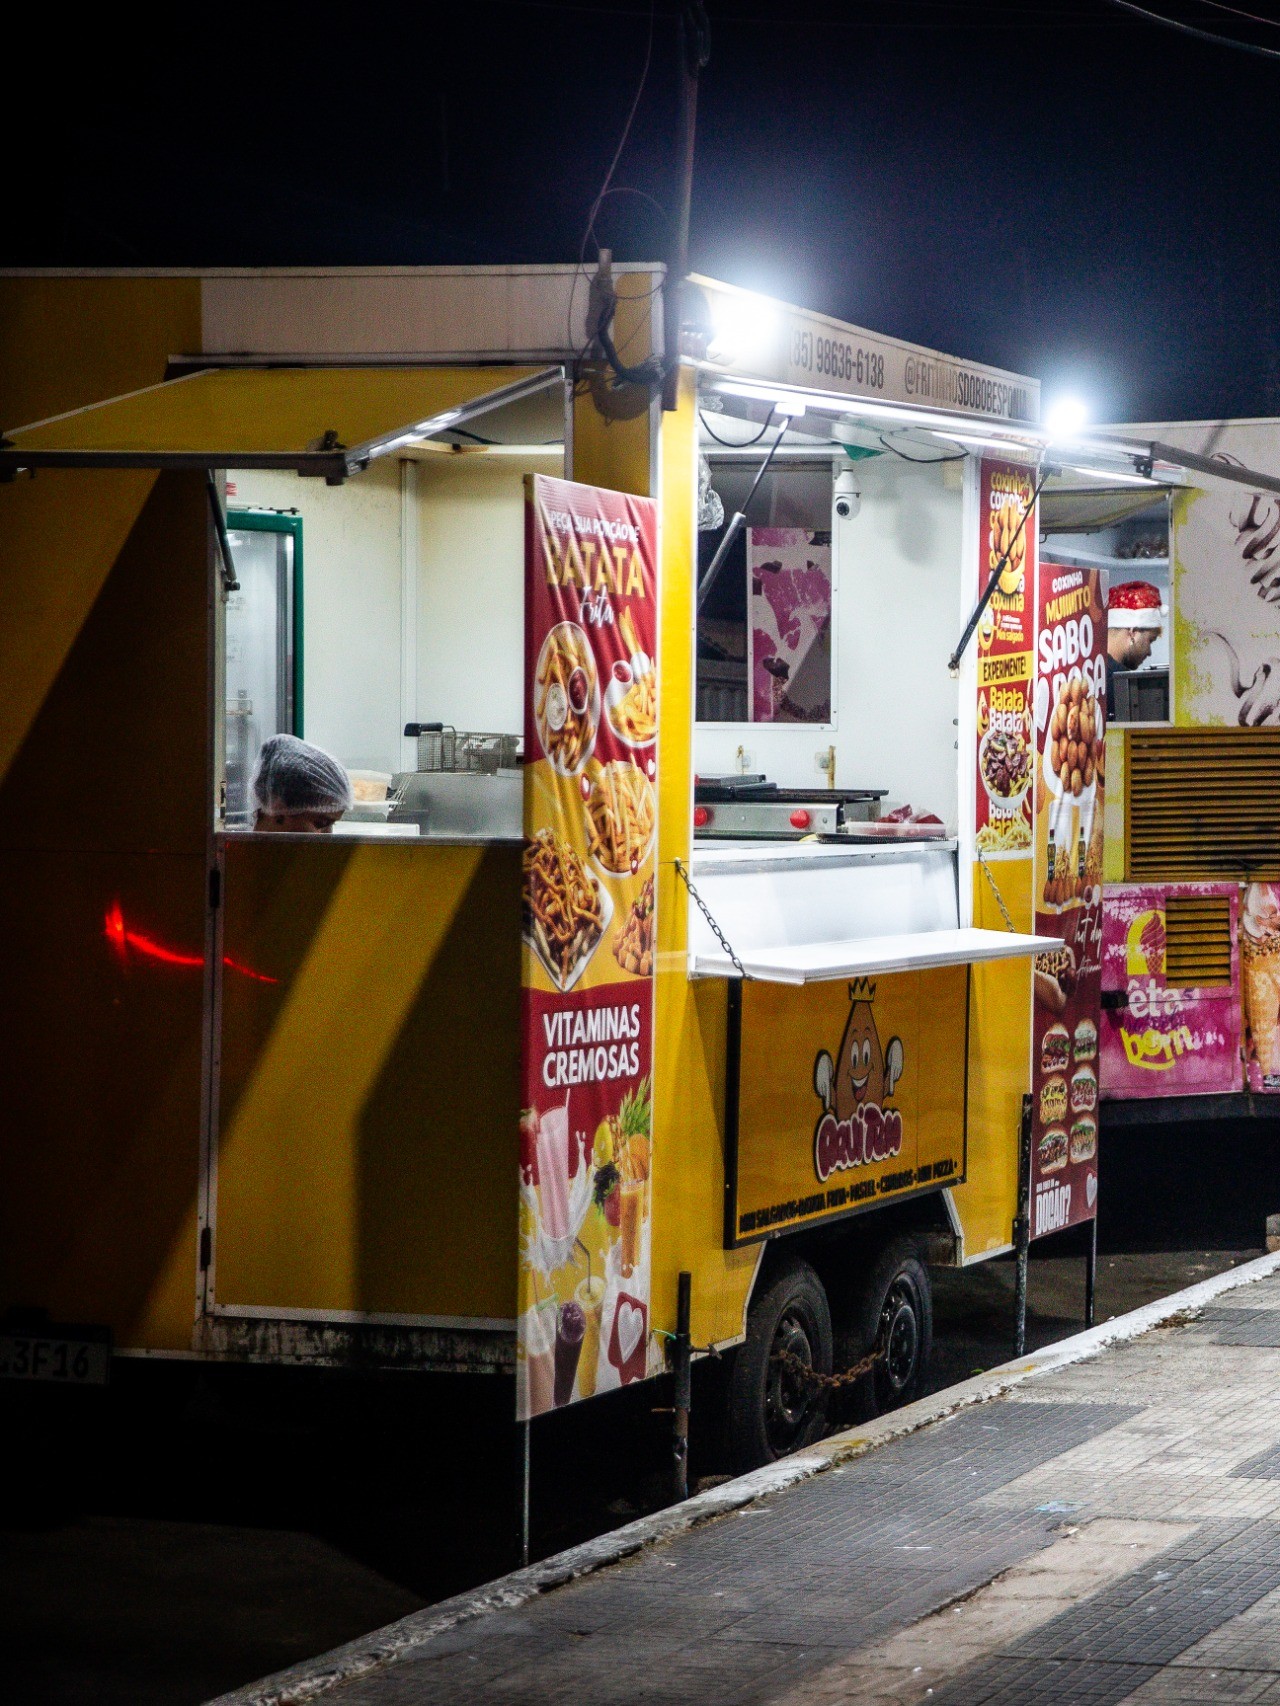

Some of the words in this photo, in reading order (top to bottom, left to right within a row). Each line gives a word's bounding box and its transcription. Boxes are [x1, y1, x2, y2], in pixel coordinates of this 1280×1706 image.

[816, 336, 884, 390] 98636-6138
[545, 535, 646, 598] BATATA
[1038, 614, 1093, 674] SABO
[989, 686, 1024, 712] Batata
[1127, 978, 1183, 1019] êta
[542, 1003, 640, 1047] VITAMINAS
[542, 1041, 640, 1087] CREMOSAS
[0, 1339, 89, 1378] 3F16
